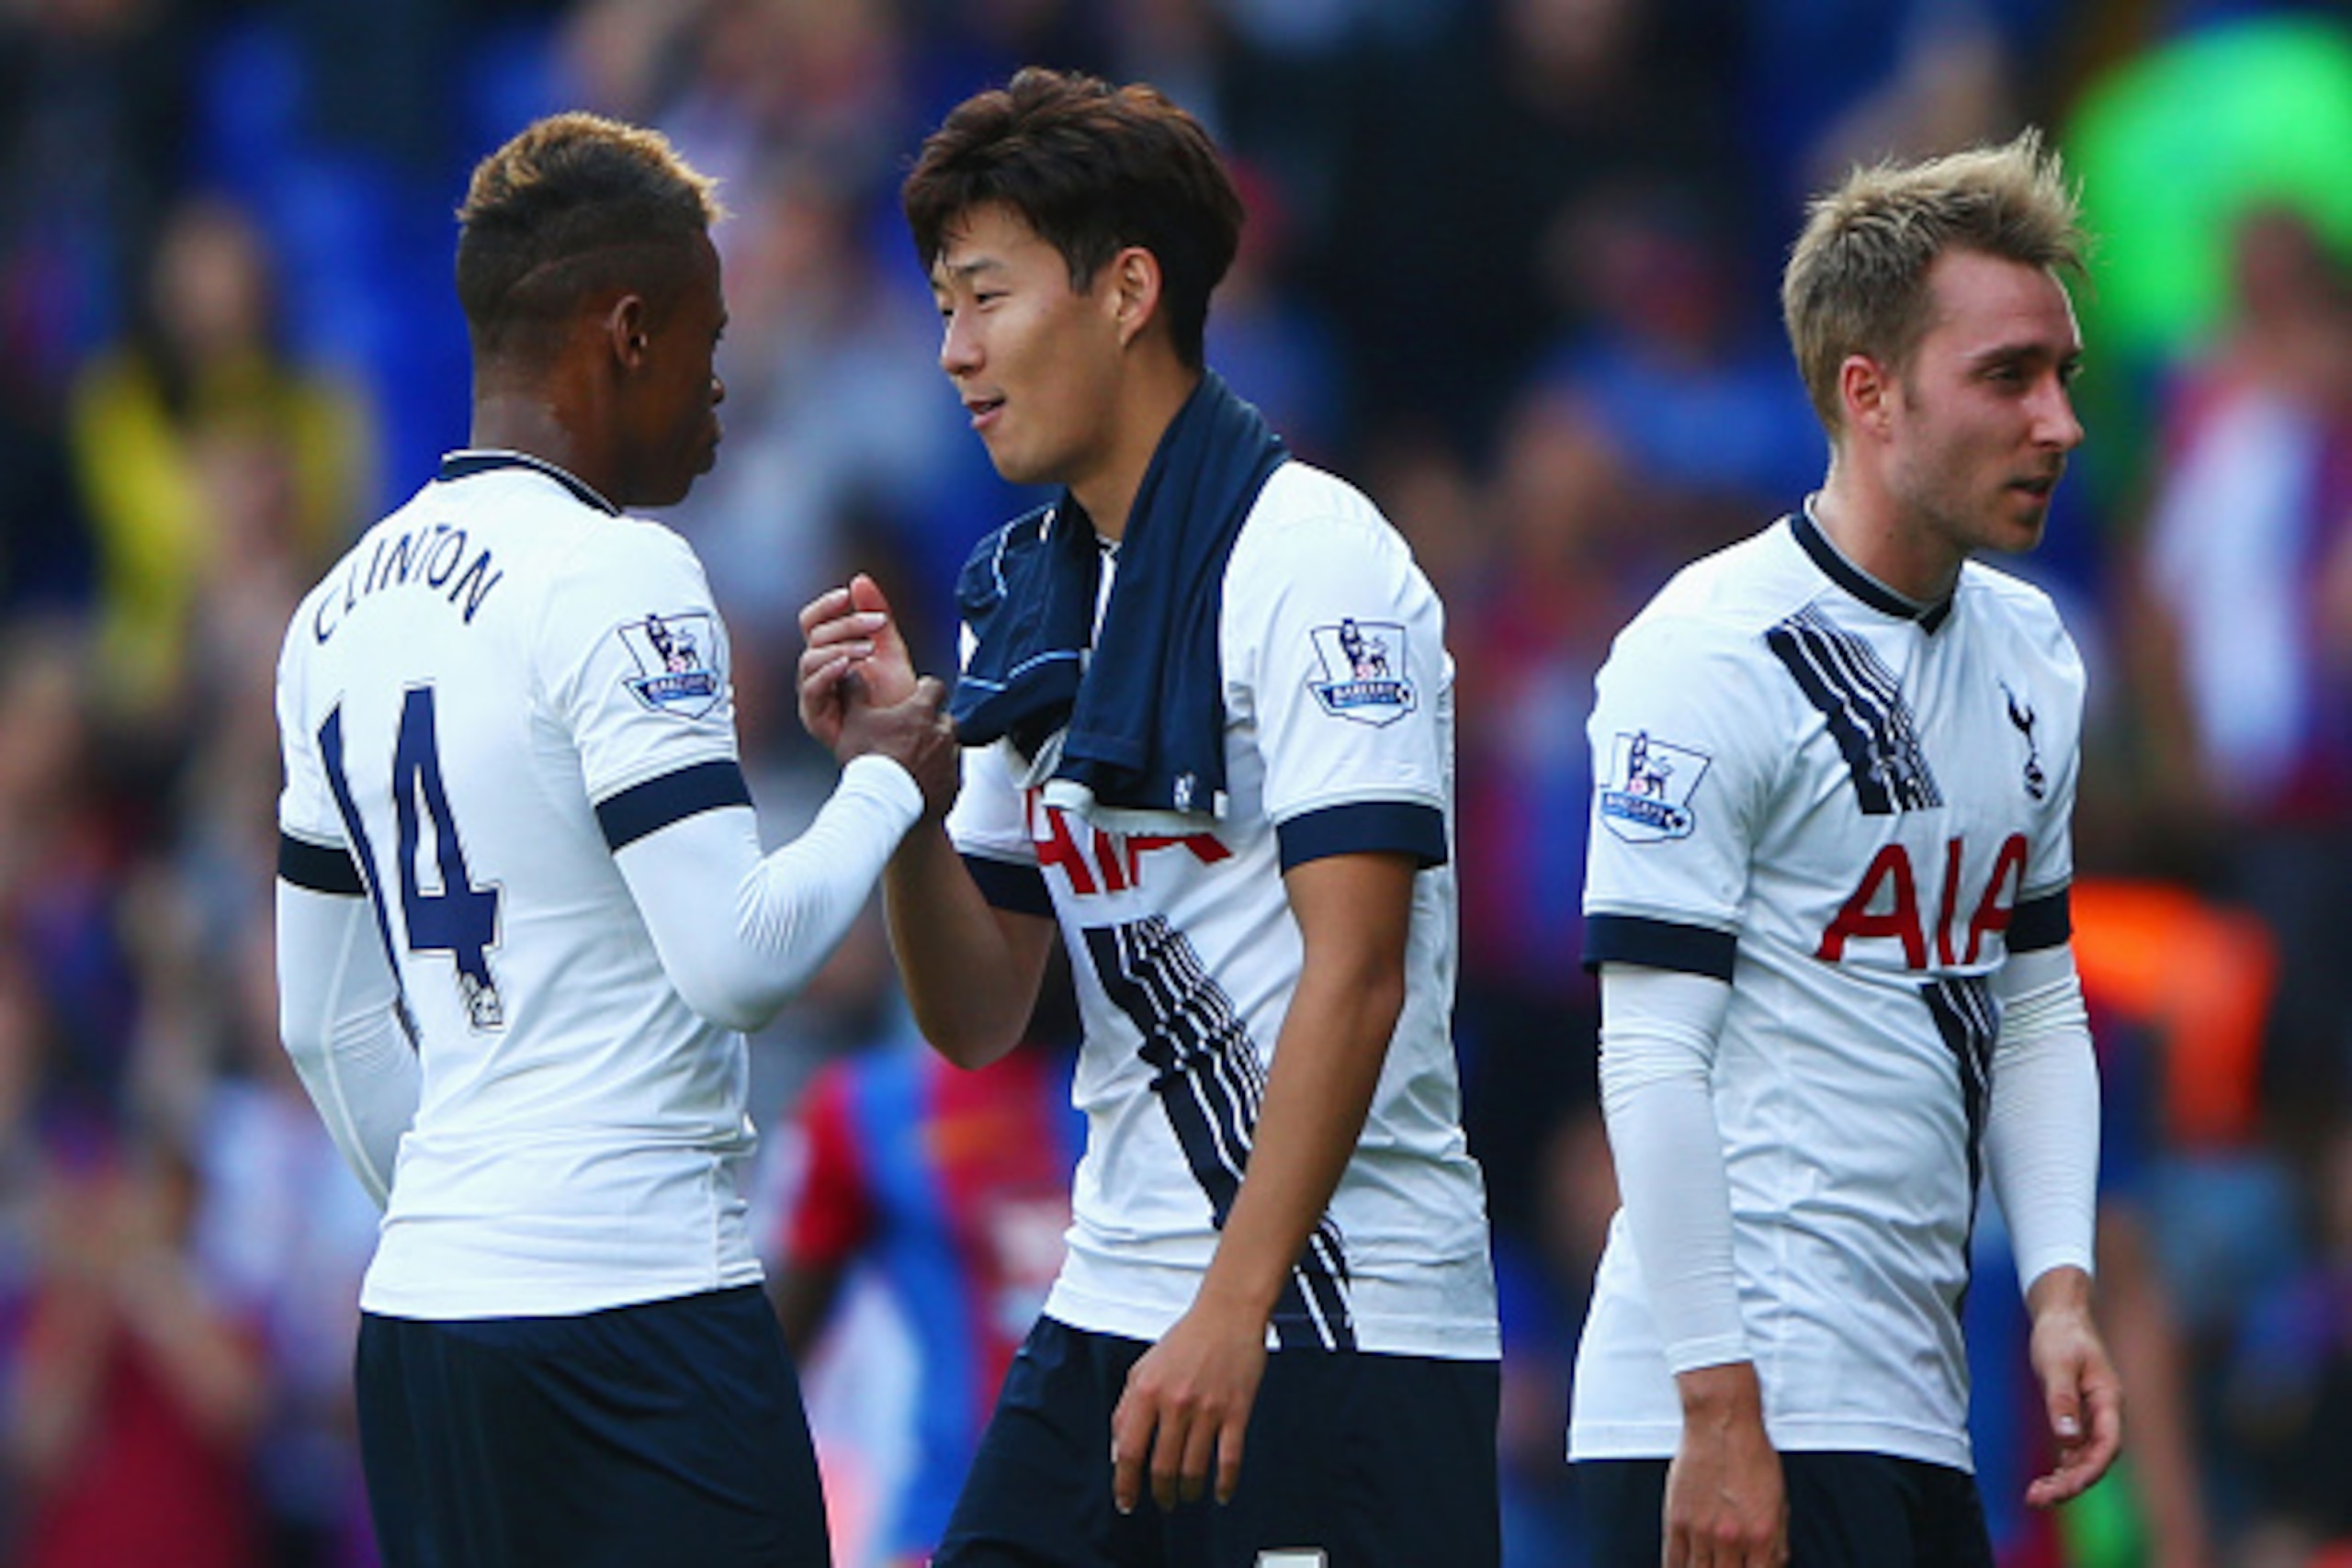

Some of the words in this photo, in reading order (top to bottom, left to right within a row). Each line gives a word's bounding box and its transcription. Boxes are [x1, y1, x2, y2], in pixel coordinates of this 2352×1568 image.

[314, 523, 504, 645] CLINTON
[317, 684, 499, 1056] 14
[1814, 833, 2028, 971] AIA
